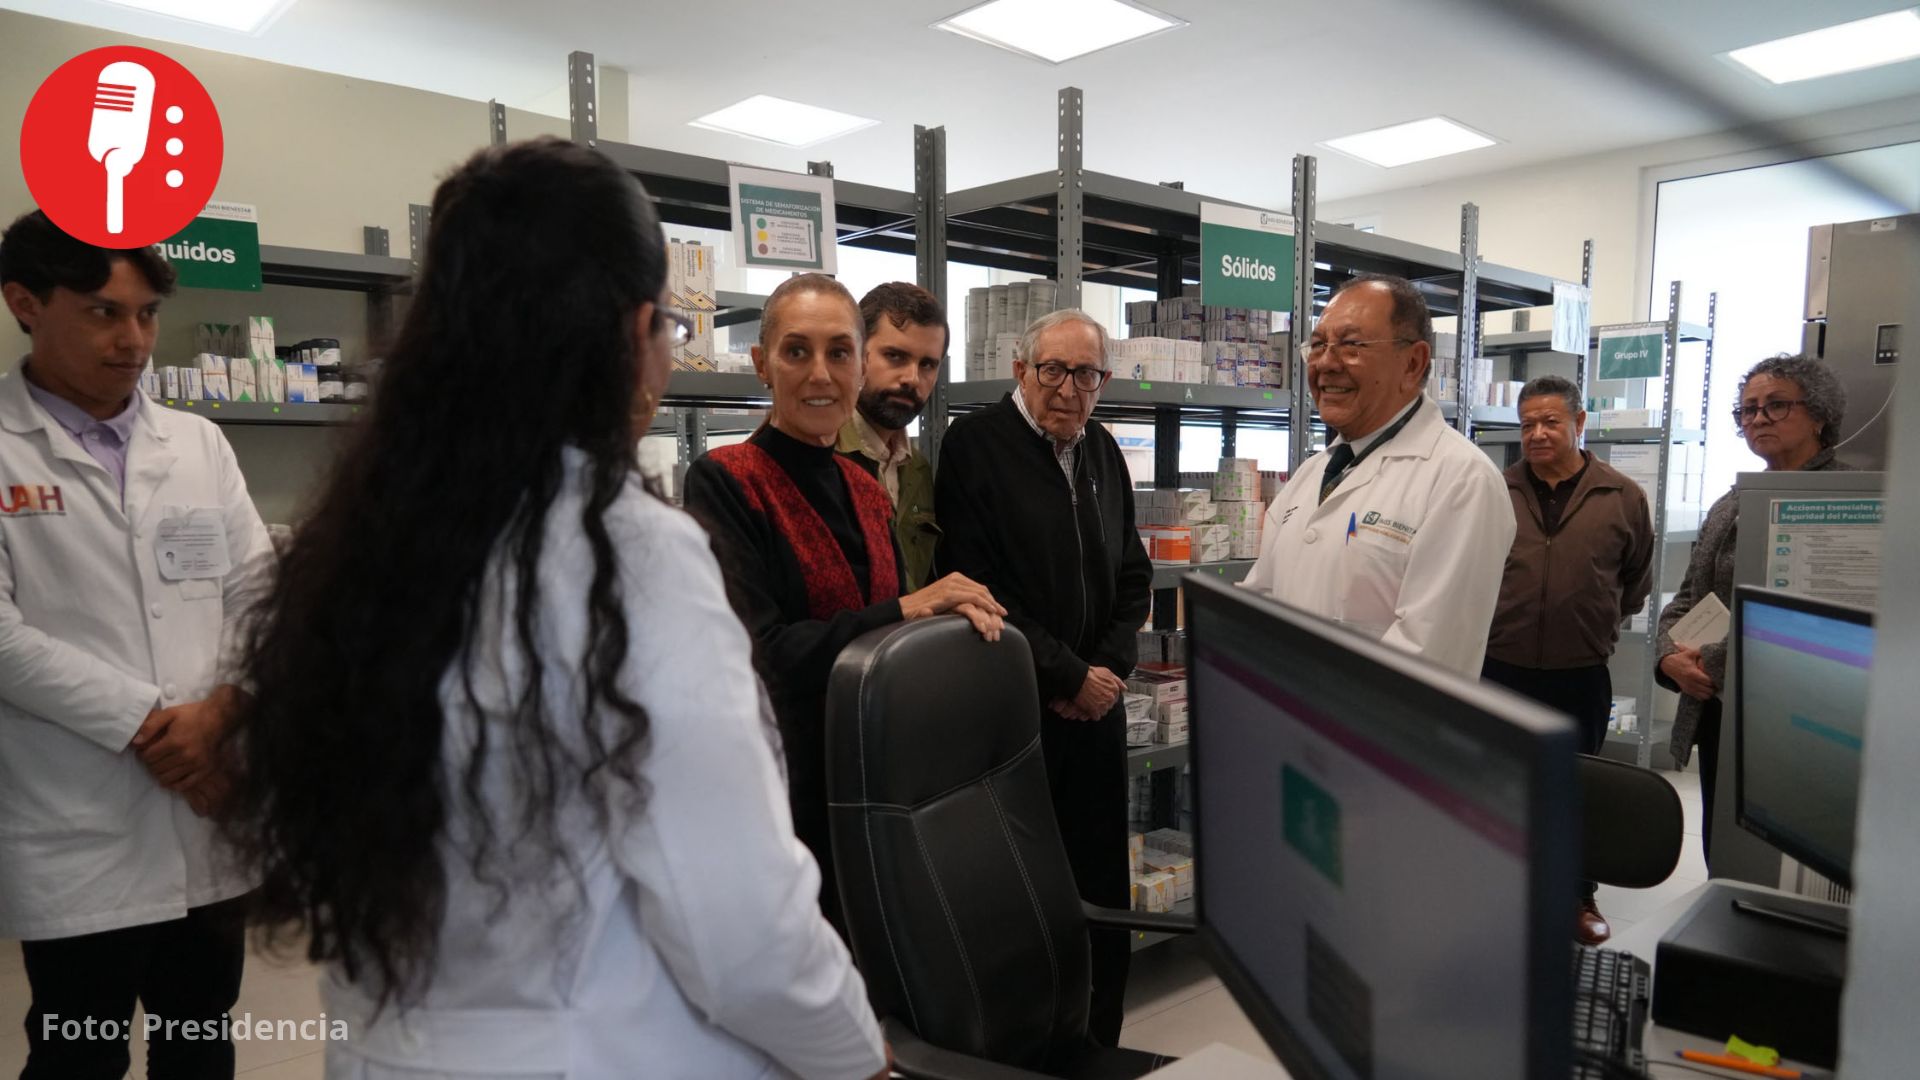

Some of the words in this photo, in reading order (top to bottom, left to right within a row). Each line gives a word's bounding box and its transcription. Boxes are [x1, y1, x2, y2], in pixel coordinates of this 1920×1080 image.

[741, 198, 764, 206] SISTEMA
[764, 207, 807, 218] MEDICAMENTOS
[152, 240, 236, 264] quidos
[1221, 254, 1276, 281] Sólidos
[1614, 351, 1638, 360] Grupo
[1640, 350, 1649, 358] IV
[1185, 387, 1193, 399] A
[1781, 513, 1825, 521] Seguridad
